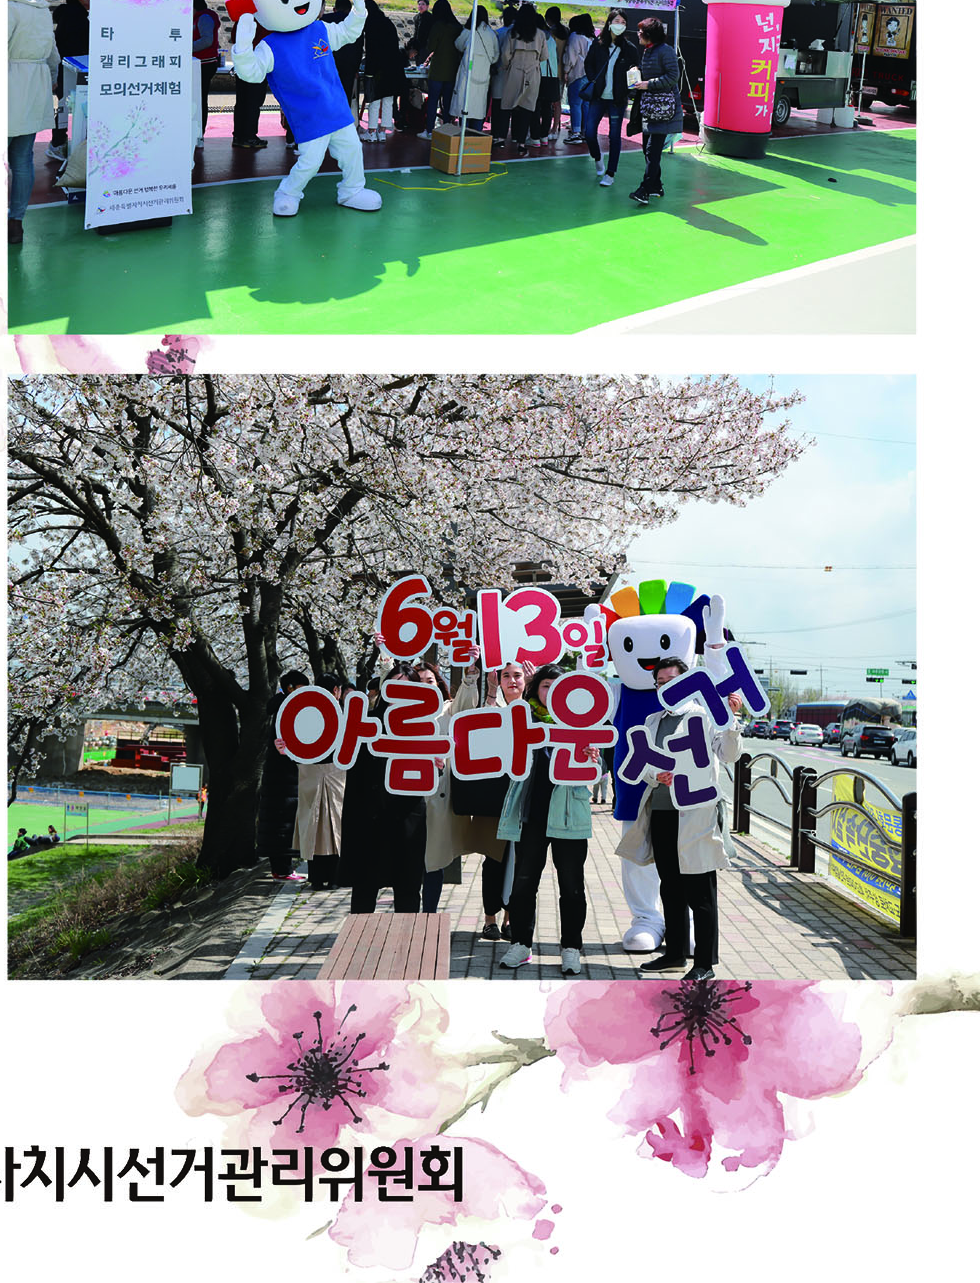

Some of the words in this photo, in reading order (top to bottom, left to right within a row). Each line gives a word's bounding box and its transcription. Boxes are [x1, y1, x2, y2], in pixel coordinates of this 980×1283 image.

[879, 6, 914, 16] WANTED
[100, 54, 182, 70] 캘리그래피
[99, 80, 182, 97] 모의선거체험
[380, 577, 474, 666] 6월
[478, 590, 607, 669] 13일
[279, 673, 615, 793] 아름다운
